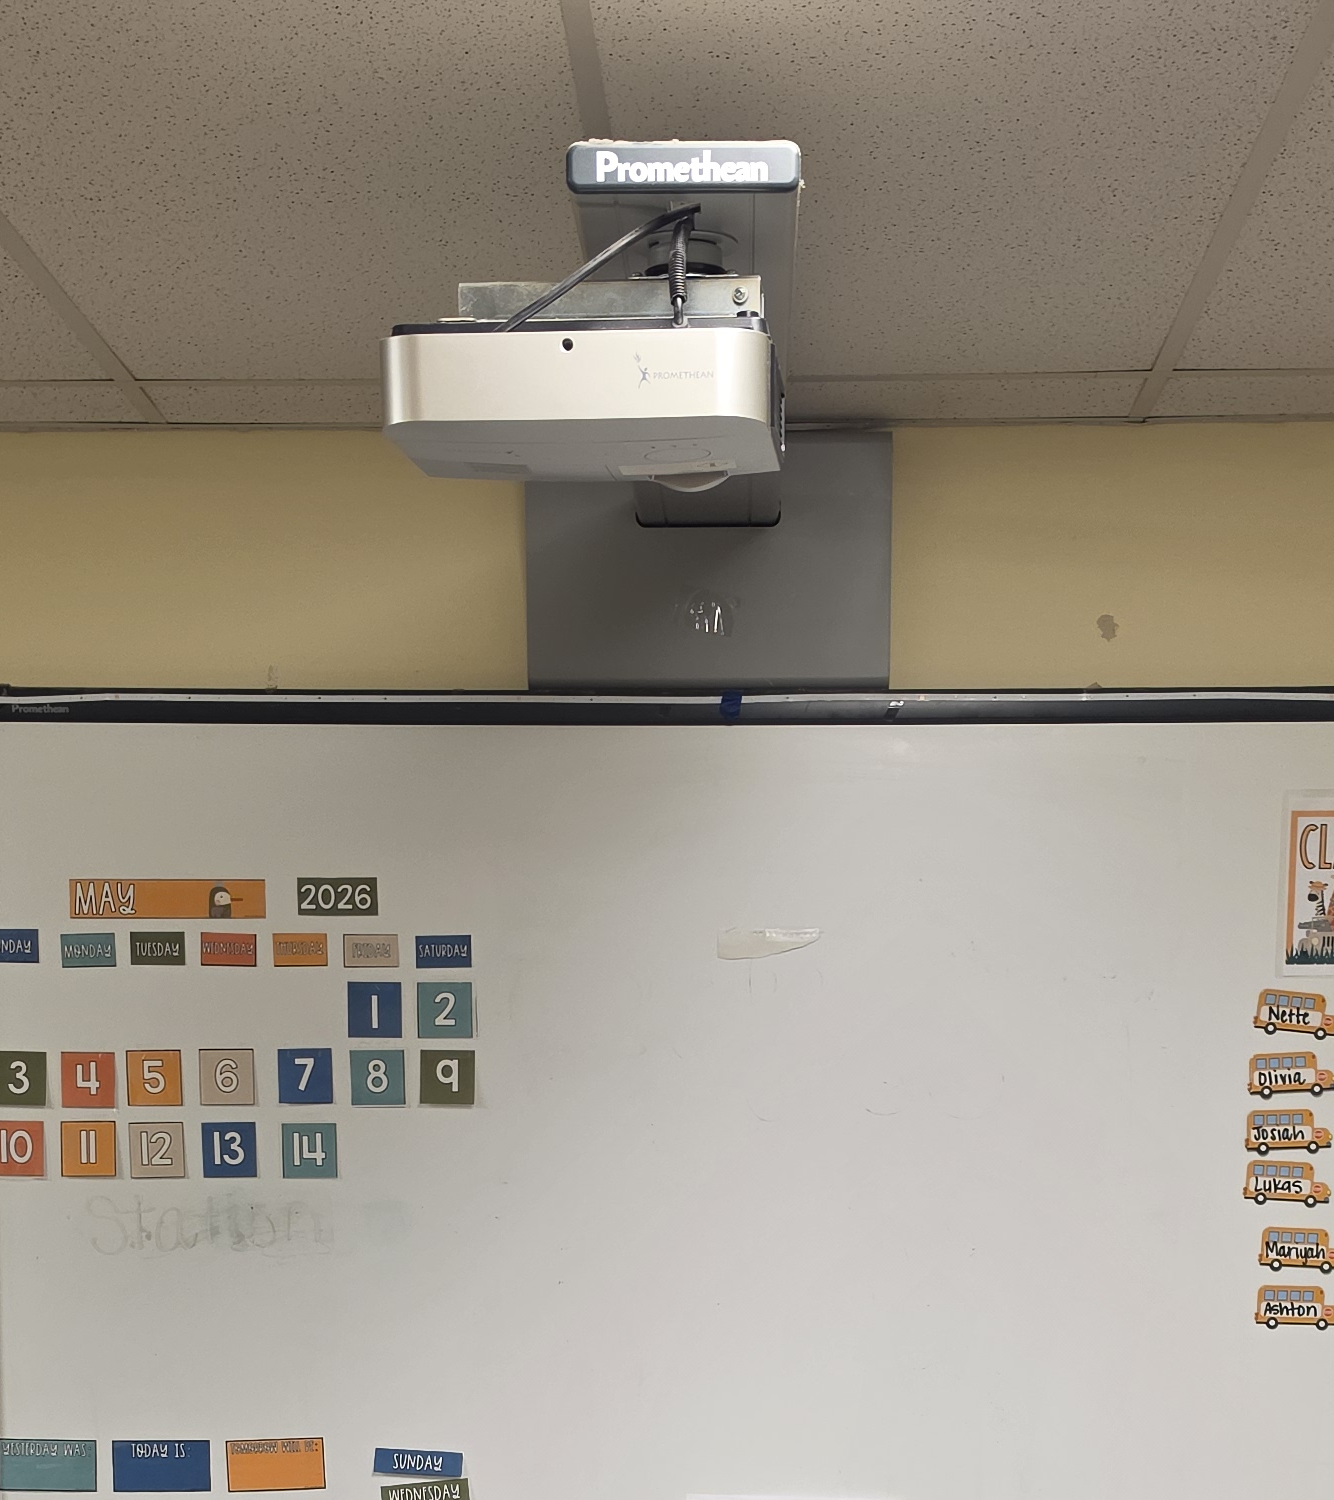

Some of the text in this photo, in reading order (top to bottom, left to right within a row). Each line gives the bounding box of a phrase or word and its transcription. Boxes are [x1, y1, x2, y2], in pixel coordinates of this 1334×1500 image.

[595, 149, 770, 184] Promethean
[653, 369, 714, 380] PROMETHEAN
[74, 881, 137, 916] MAY
[300, 884, 372, 911] 2026
[64, 943, 112, 959] MONDAY
[135, 942, 180, 956] TUESDAY
[202, 942, 254, 955] WEDNESDAY
[418, 943, 468, 958] SATURDAY
[433, 992, 457, 1027] 2
[1268, 1006, 1310, 1026] Nette
[141, 1060, 166, 1095] 5
[365, 1058, 390, 1094] 8
[435, 1058, 461, 1093] 9
[1258, 1067, 1306, 1086] Olivia
[1254, 1124, 1305, 1143] Josiah
[0, 1129, 33, 1165] 10
[140, 1131, 173, 1167] 12
[213, 1131, 246, 1167] 13
[1254, 1176, 1303, 1194] Lukas
[1265, 1240, 1326, 1266] Mariyah
[1264, 1301, 1318, 1318] Ashton
[131, 1443, 168, 1458] TODAY
[392, 1453, 443, 1473] SUNDAY
